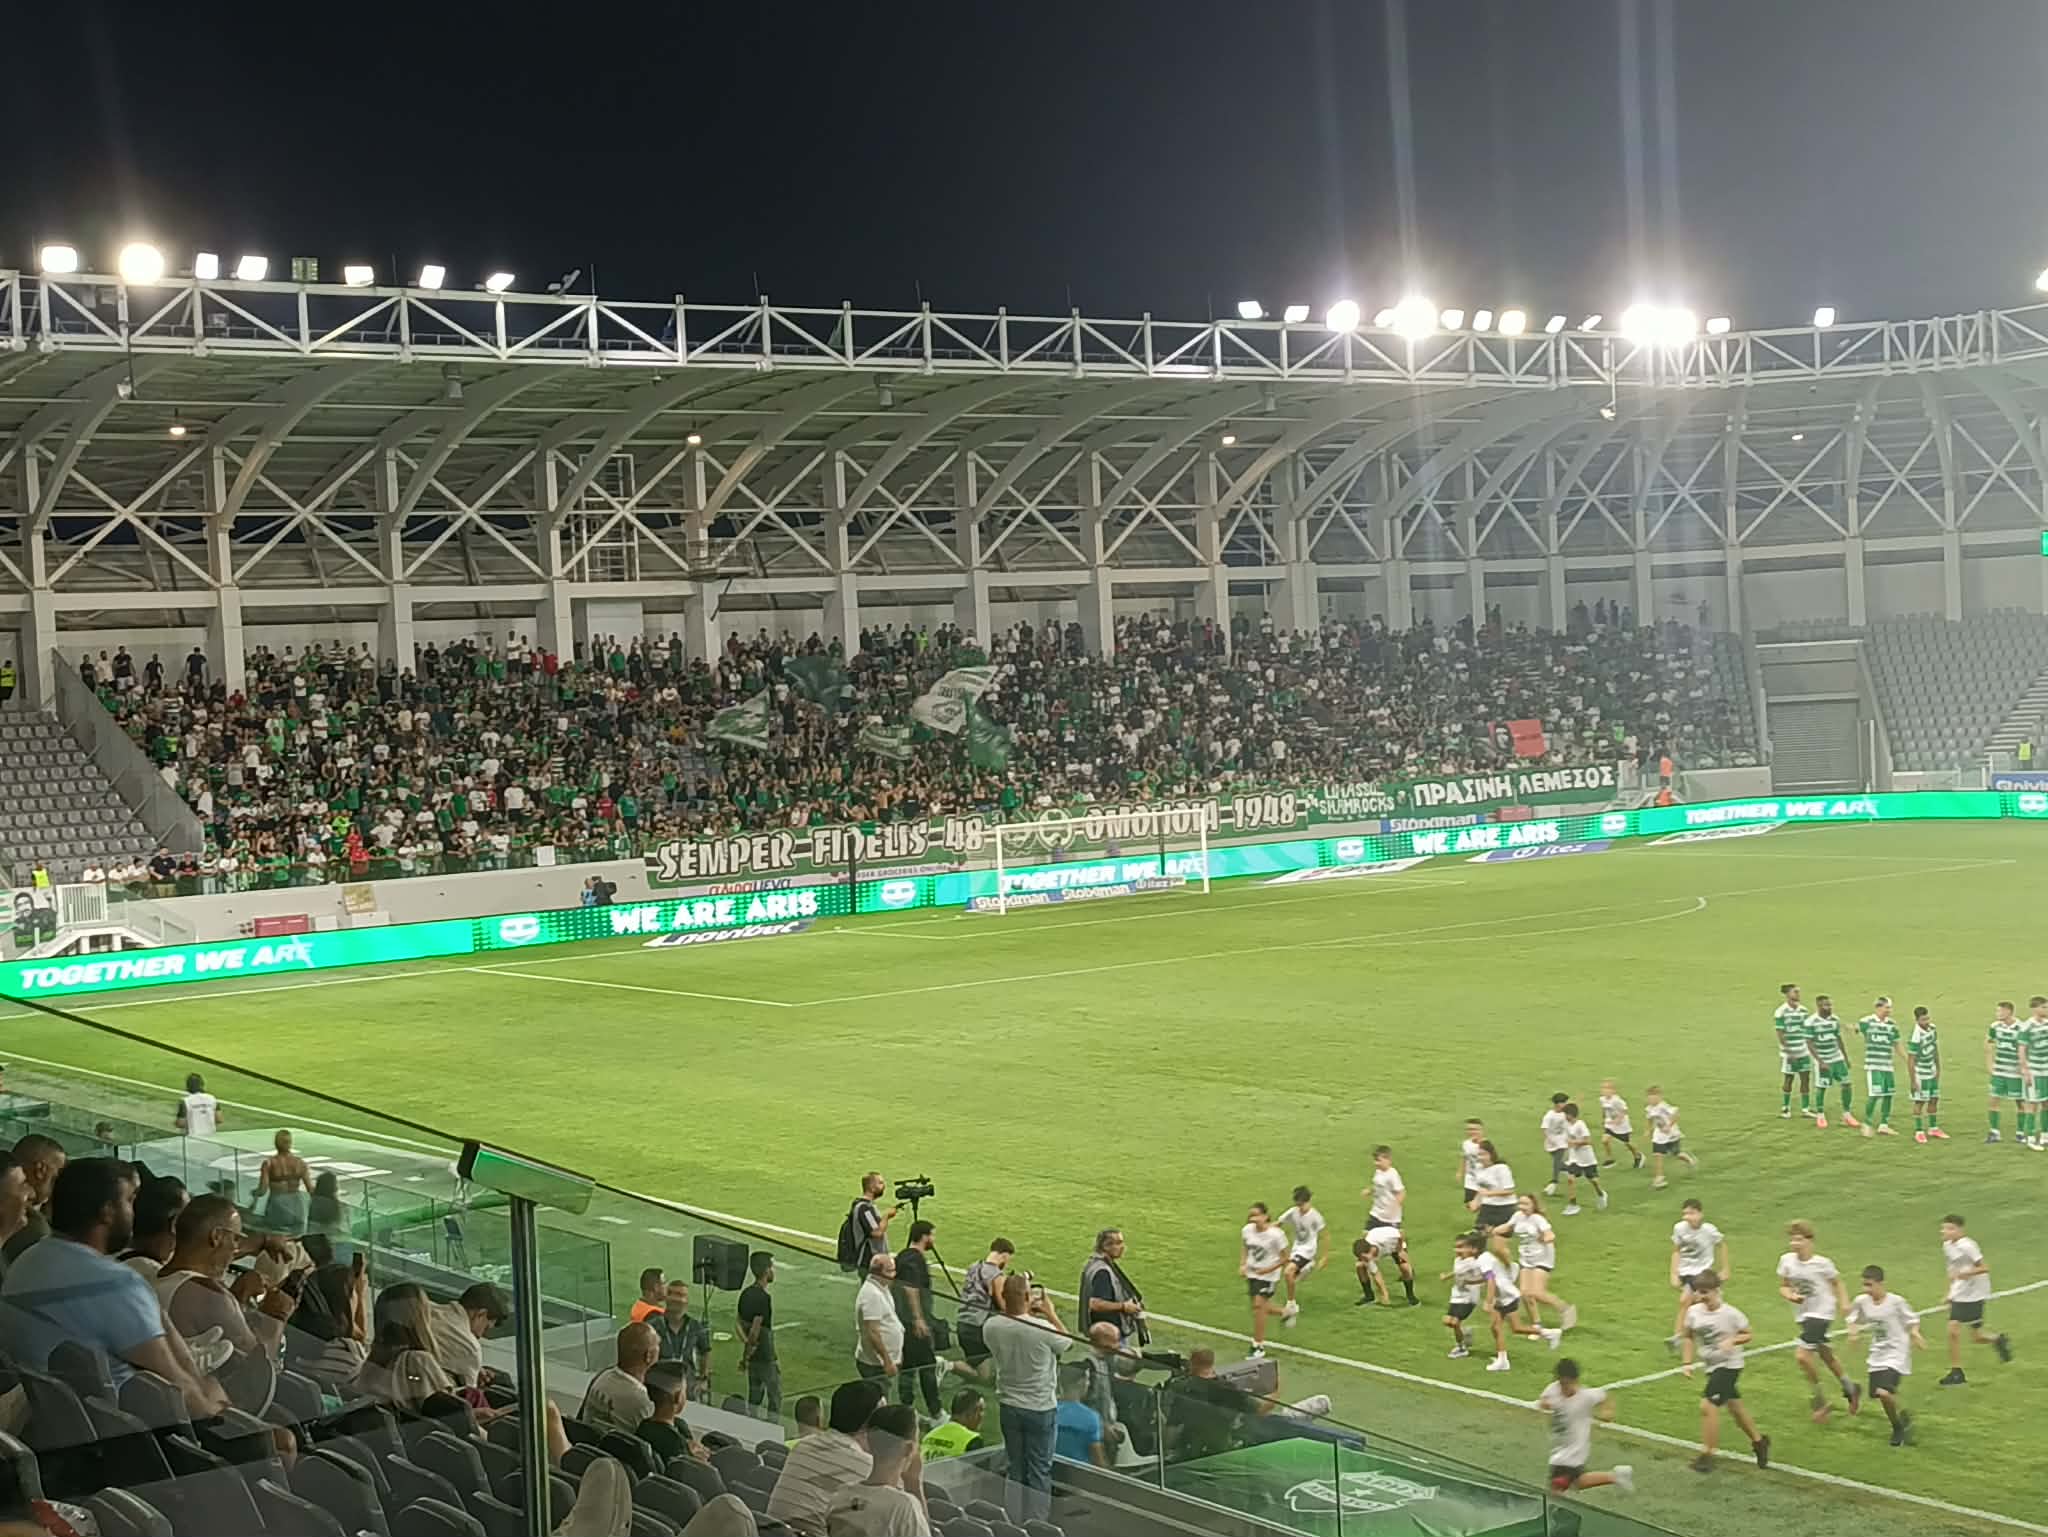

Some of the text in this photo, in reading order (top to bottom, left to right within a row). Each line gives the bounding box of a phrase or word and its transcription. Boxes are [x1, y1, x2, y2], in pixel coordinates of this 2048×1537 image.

[1413, 765, 1615, 807] ΠΡΑΣΙΝΗ ΛΕΜΕΣΟΣ
[1233, 794, 1297, 829] 1948
[1785, 801, 1828, 817] WE
[658, 816, 984, 880] SEMPER FIDELIS 48
[1412, 821, 1561, 854] WE ARE ARIS
[1122, 859, 1159, 883] WE
[609, 890, 819, 935] WE ARE ARIS
[20, 954, 186, 990] TOGETHER
[195, 948, 248, 973] WE
